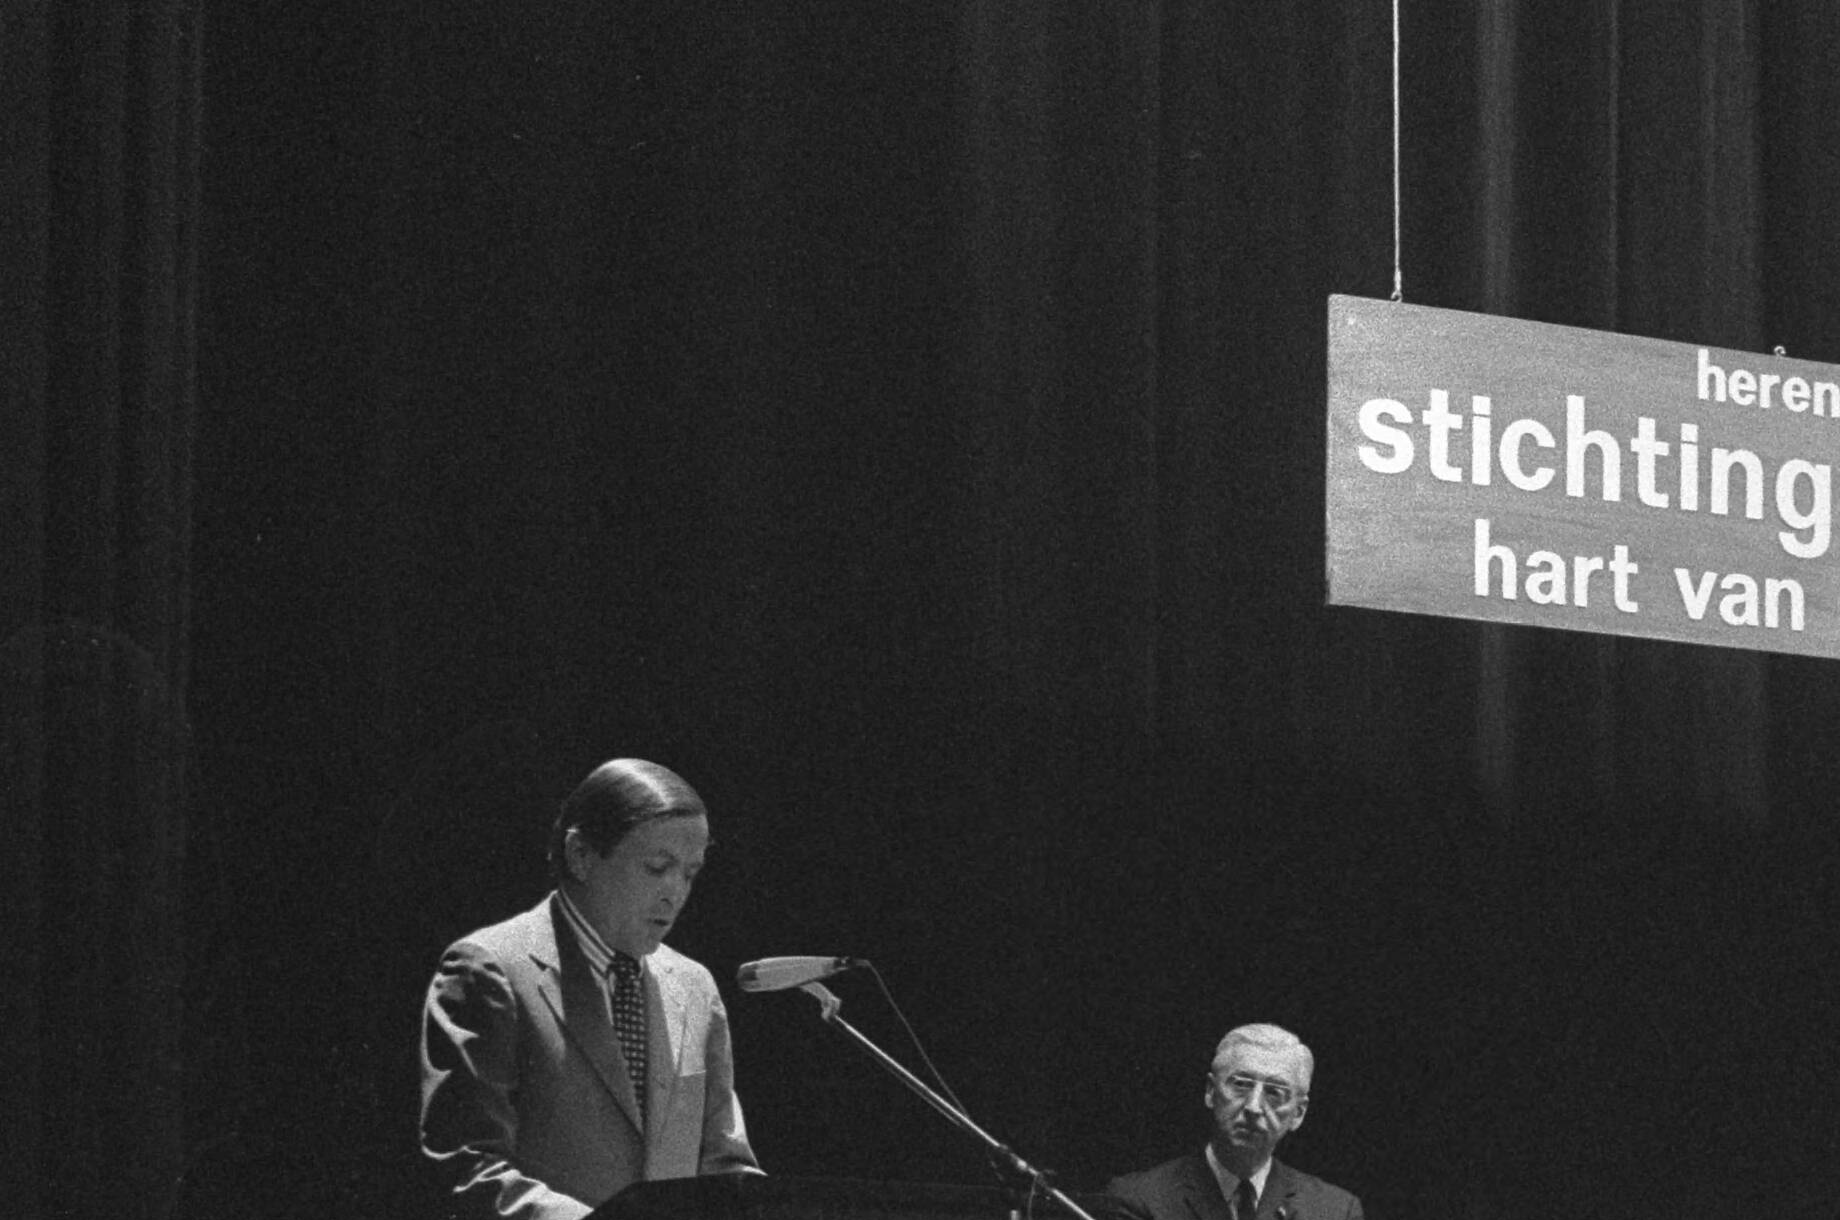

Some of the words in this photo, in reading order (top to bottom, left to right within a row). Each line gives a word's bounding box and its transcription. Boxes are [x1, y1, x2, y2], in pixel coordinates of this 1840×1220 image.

[1358, 388, 1832, 558] stichting
[1475, 518, 1638, 612] hart
[1675, 567, 1804, 630] van
